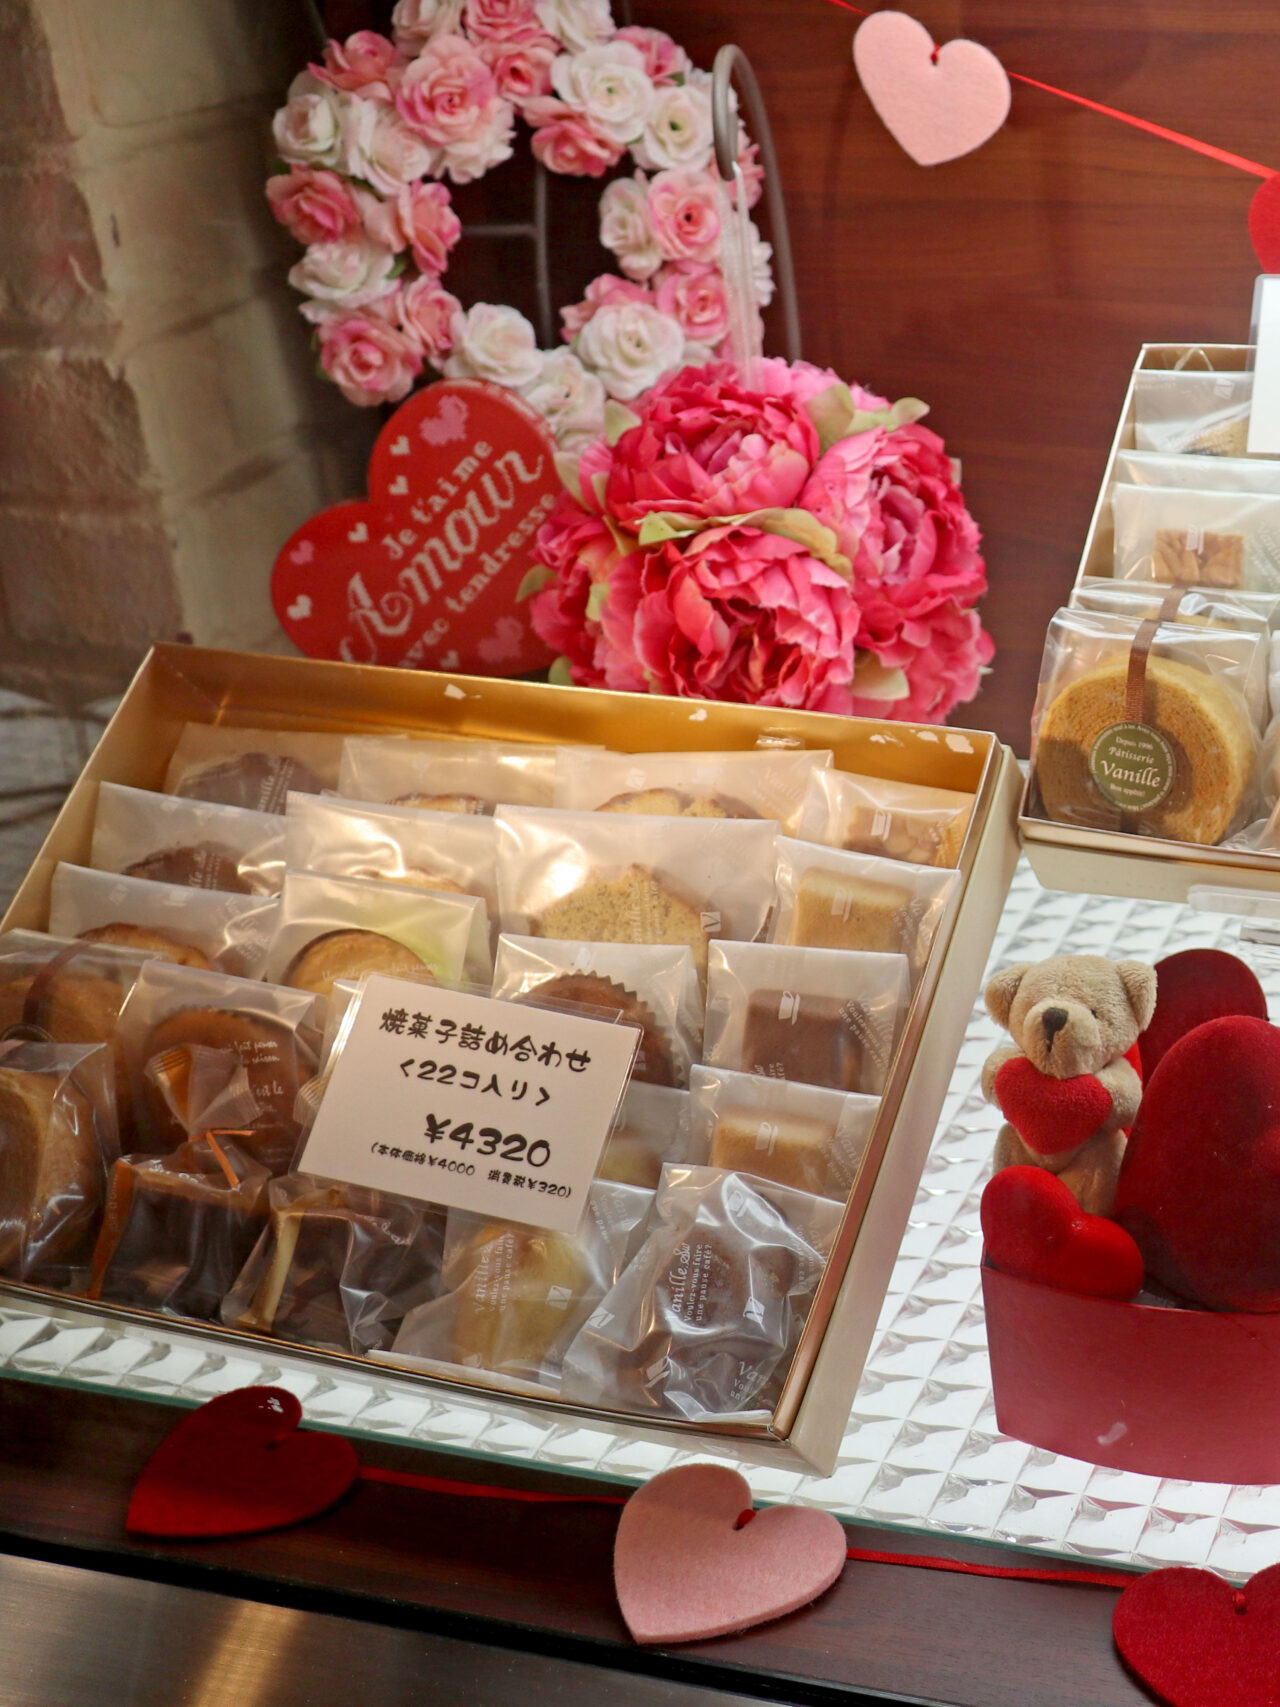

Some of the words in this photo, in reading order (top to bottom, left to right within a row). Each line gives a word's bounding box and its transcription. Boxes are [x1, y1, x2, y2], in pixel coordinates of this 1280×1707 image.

[381, 528, 418, 560] Je
[411, 440, 493, 523] t'aime
[339, 450, 545, 666] Amour
[446, 493, 556, 613] tendresse
[1100, 760, 1161, 788] Vanille
[379, 1007, 591, 1073] 焼菓子詰め合わせ
[848, 1024, 871, 1049] pause
[423, 1112, 551, 1168] ¥4320
[682, 1267, 701, 1323] Voulez-vous
[692, 1243, 704, 1267] faire
[703, 1243, 713, 1271] café?
[695, 1303, 705, 1322] une
[698, 1272, 709, 1302] pause
